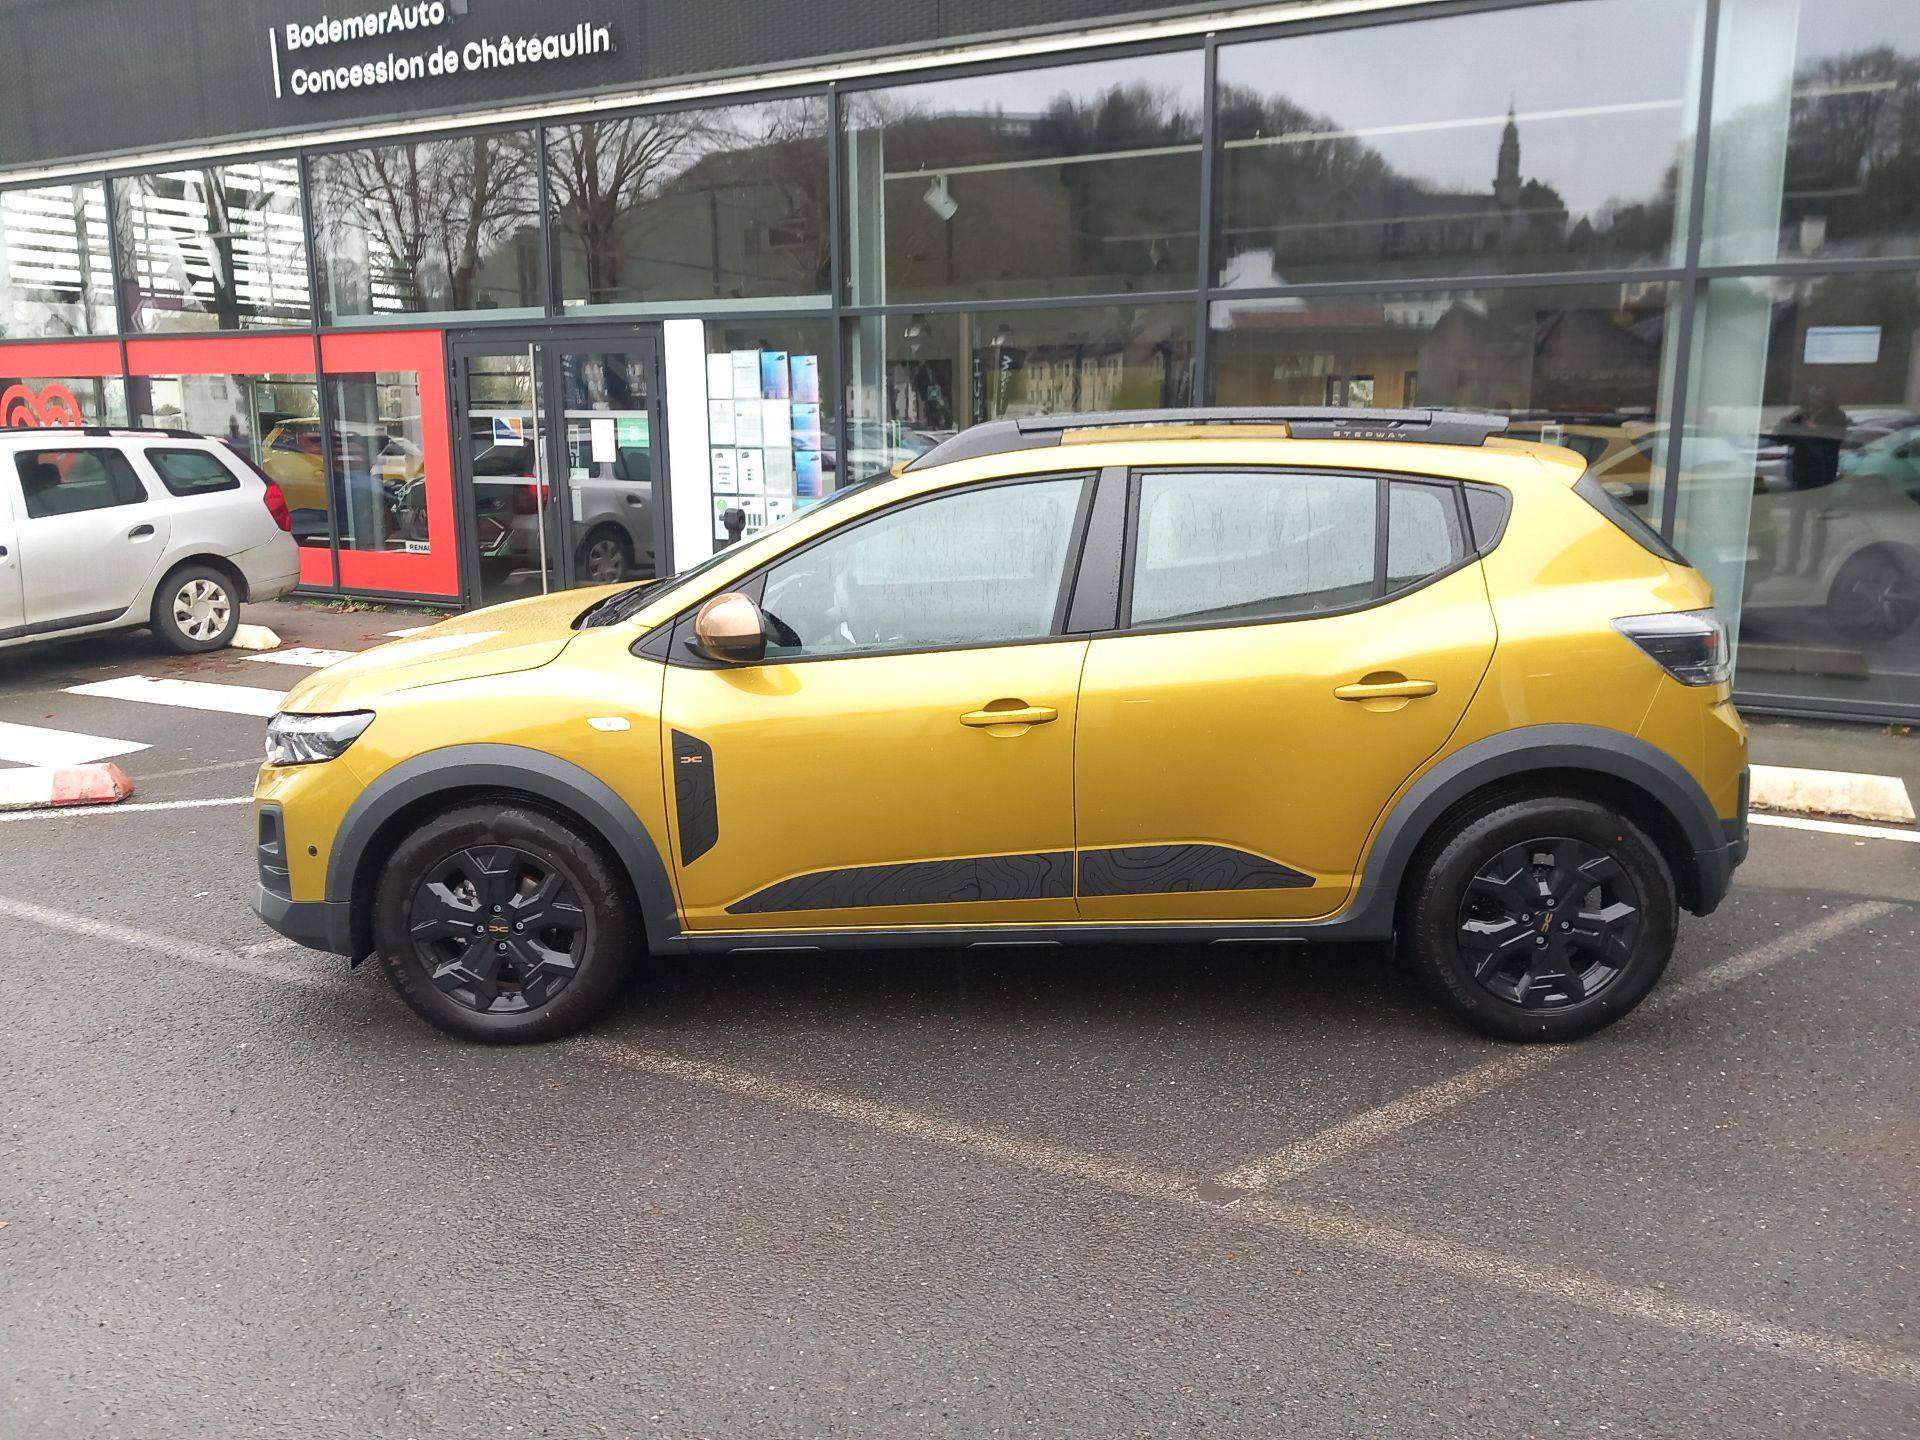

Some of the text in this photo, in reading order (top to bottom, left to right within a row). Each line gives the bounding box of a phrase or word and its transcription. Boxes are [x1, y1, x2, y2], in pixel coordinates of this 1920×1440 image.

[286, 1, 445, 50] BodemerAuto
[291, 23, 610, 95] Concession de Châteaulin
